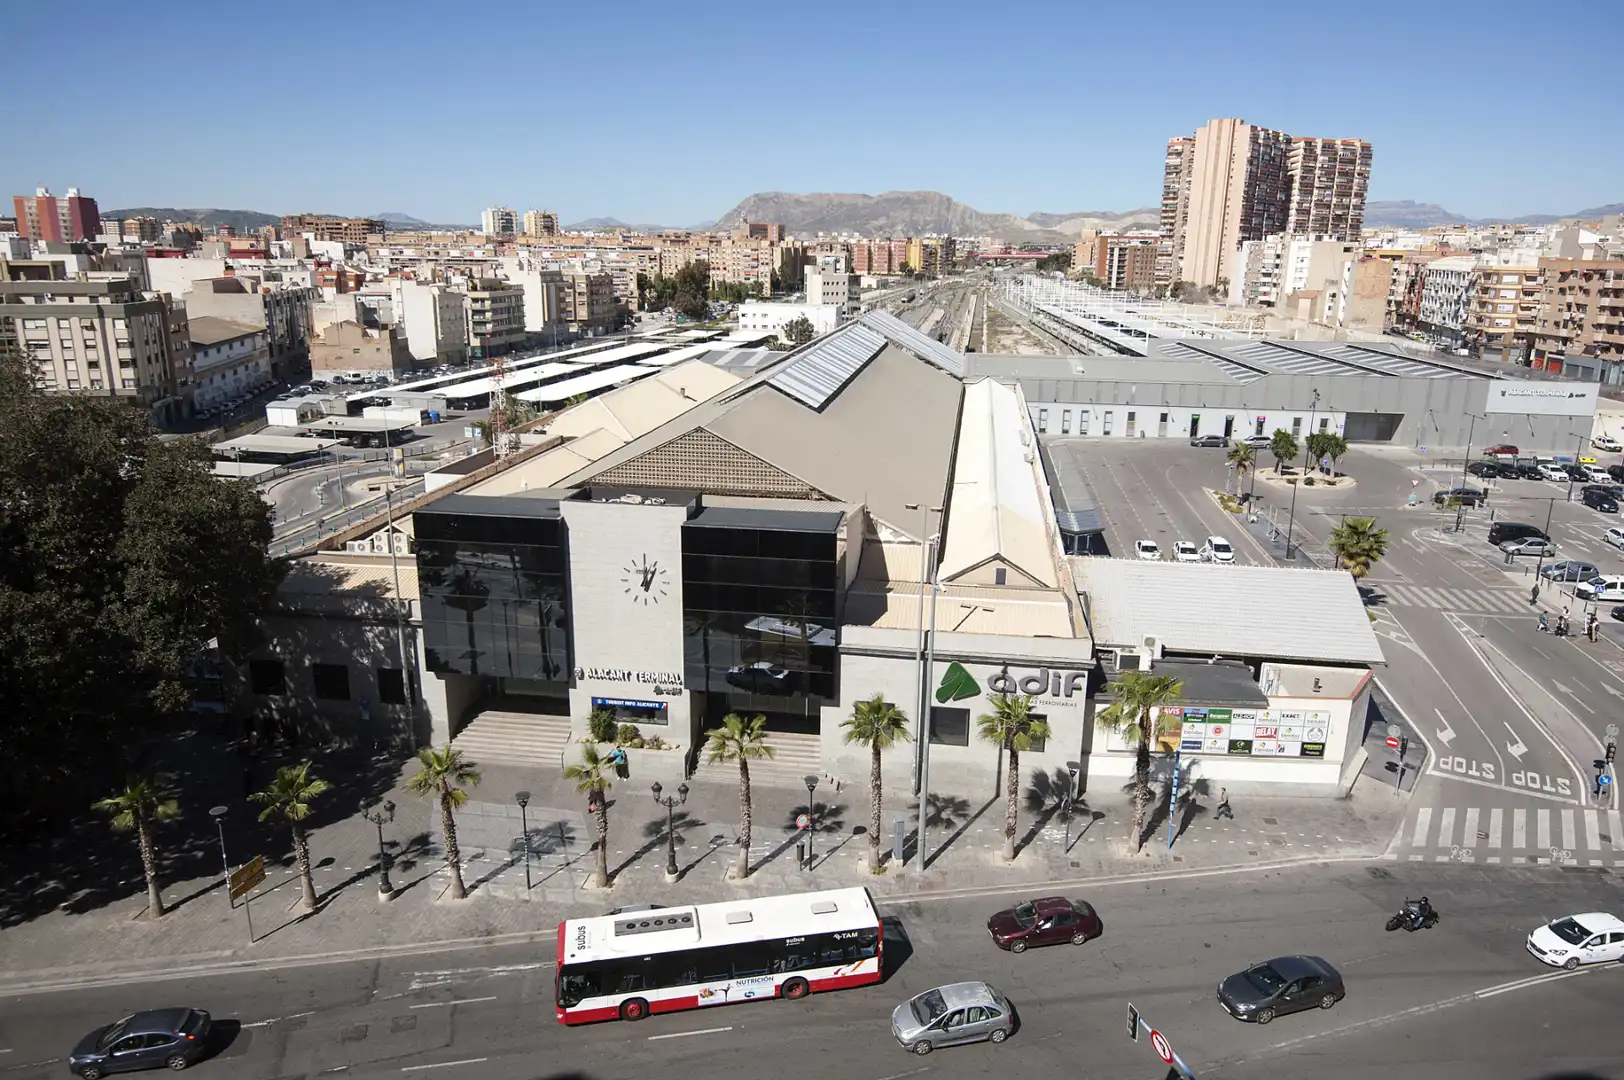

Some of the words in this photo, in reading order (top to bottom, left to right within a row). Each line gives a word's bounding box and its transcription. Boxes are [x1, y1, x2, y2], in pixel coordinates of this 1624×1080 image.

[586, 667, 631, 681] ALACANT
[634, 671, 683, 685] TERMINAL
[987, 667, 1086, 698] adif
[1039, 700, 1077, 708] FERROVIARIAS
[1256, 727, 1275, 737] RELAY
[1439, 755, 1495, 780] STOP
[1512, 770, 1572, 796] STOP
[575, 925, 586, 951] subus
[736, 975, 774, 986] NUTRICIÓN
